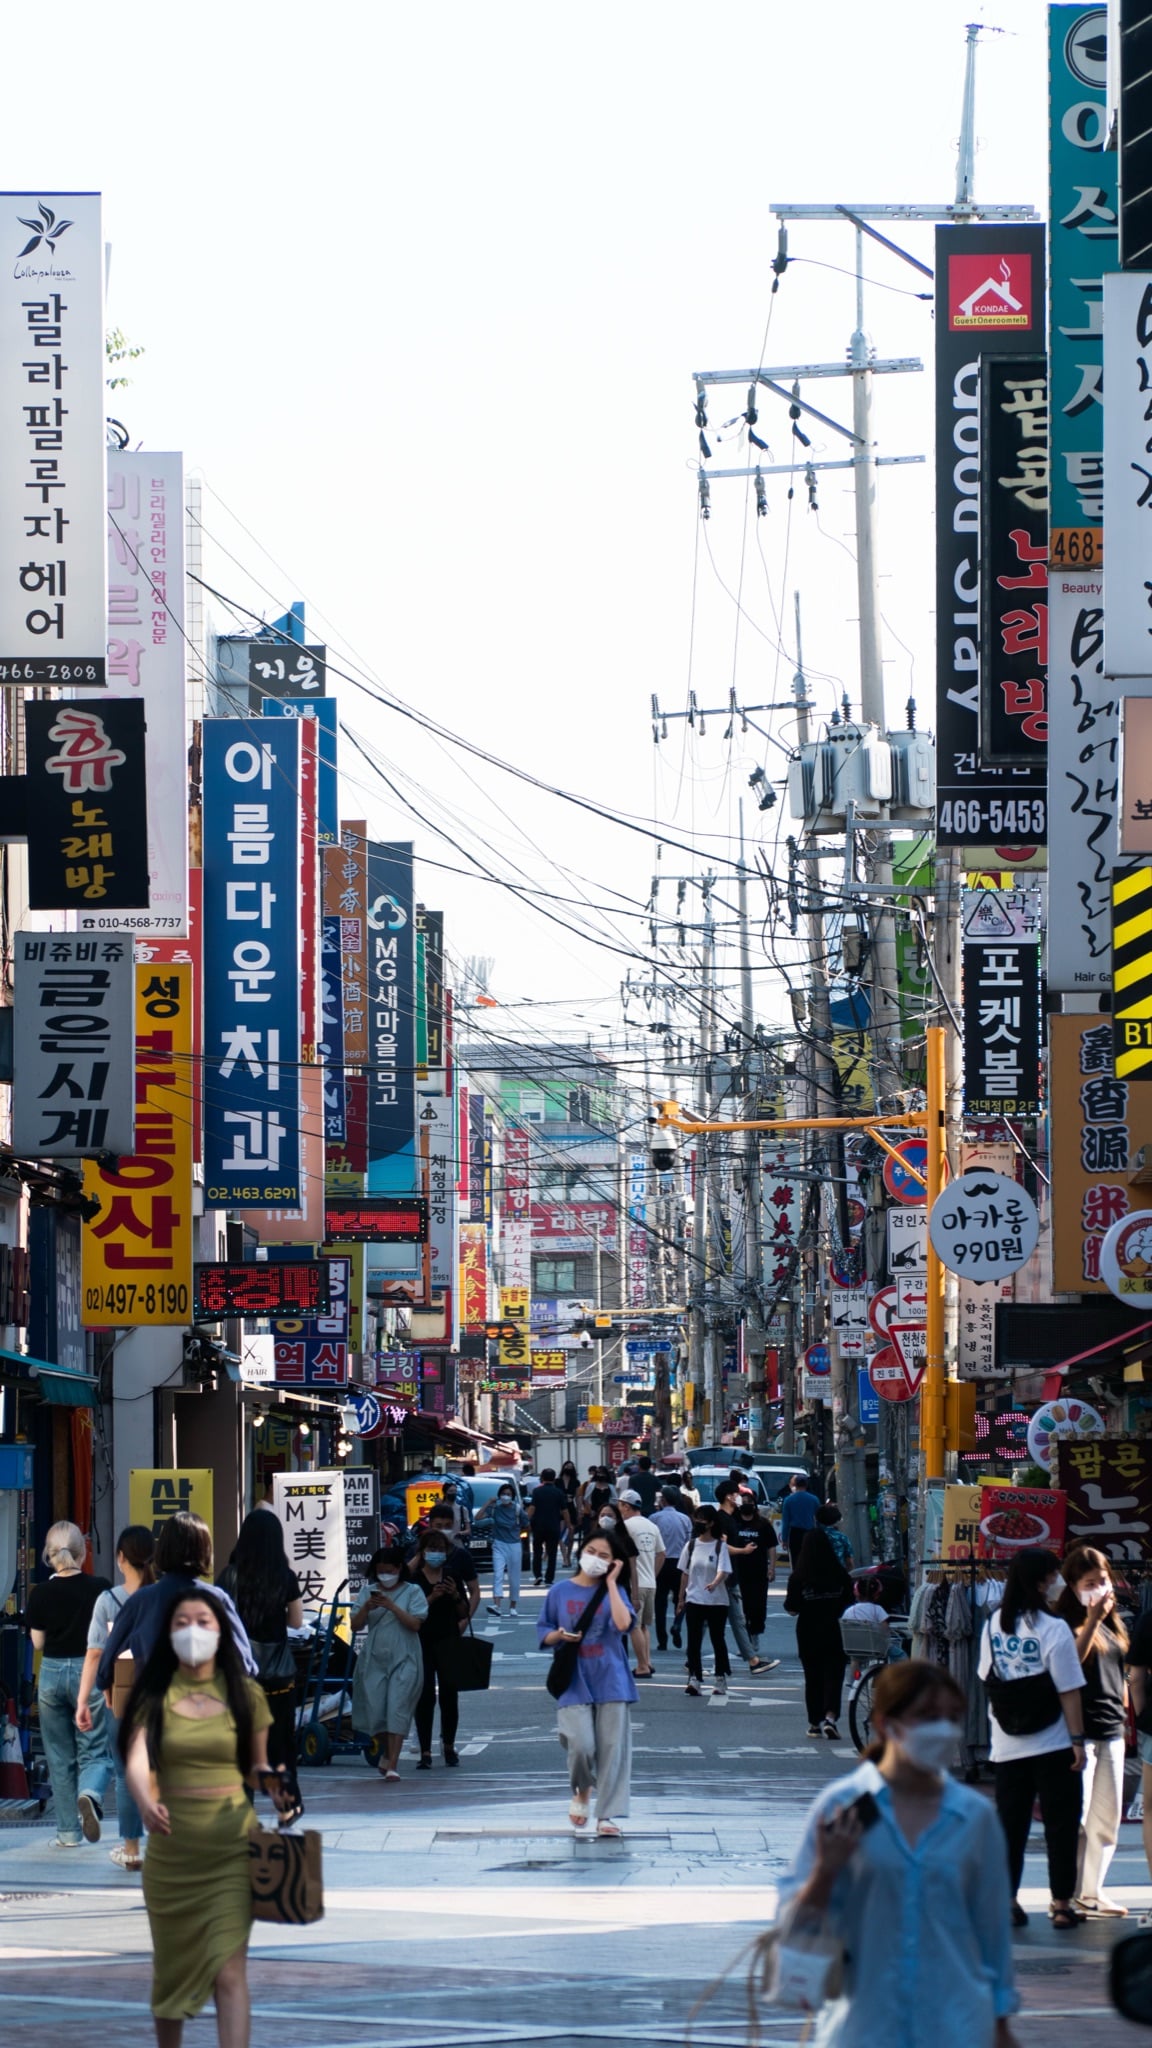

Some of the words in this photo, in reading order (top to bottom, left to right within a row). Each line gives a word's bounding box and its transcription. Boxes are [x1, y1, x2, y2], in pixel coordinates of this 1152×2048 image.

[974, 304, 1009, 313] KONDAE
[955, 316, 977, 325] Guest
[977, 316, 1027, 324] Oneroomtels
[1062, 583, 1103, 595] Beauty
[152, 610, 168, 645] 전문
[48, 710, 124, 792] 휴
[940, 800, 1045, 833] 466-5453
[61, 800, 115, 899] 노래방
[98, 918, 182, 929] 010-4568-7737
[24, 941, 124, 963] 비쥬비쥬
[1074, 972, 1096, 982] Hair
[978, 948, 1025, 1097] 포켓볼
[38, 969, 111, 1148] 금은시계
[969, 1100, 1001, 1112] 건대점
[1018, 1101, 1035, 1112] 2F
[208, 1186, 298, 1201] 02.463.6291
[431, 1153, 447, 1225] 체형교정
[942, 1199, 1029, 1235] 마카롱
[953, 1237, 1024, 1265] 990원
[904, 1280, 928, 1290] 구간
[833, 1293, 866, 1303] 견인지역
[247, 1368, 268, 1376] HAIR
[275, 1342, 347, 1385] 열쇠
[380, 1357, 414, 1378] 부킹
[1068, 1442, 1146, 1479] 팝콘
[348, 1537, 369, 1546] HOT
